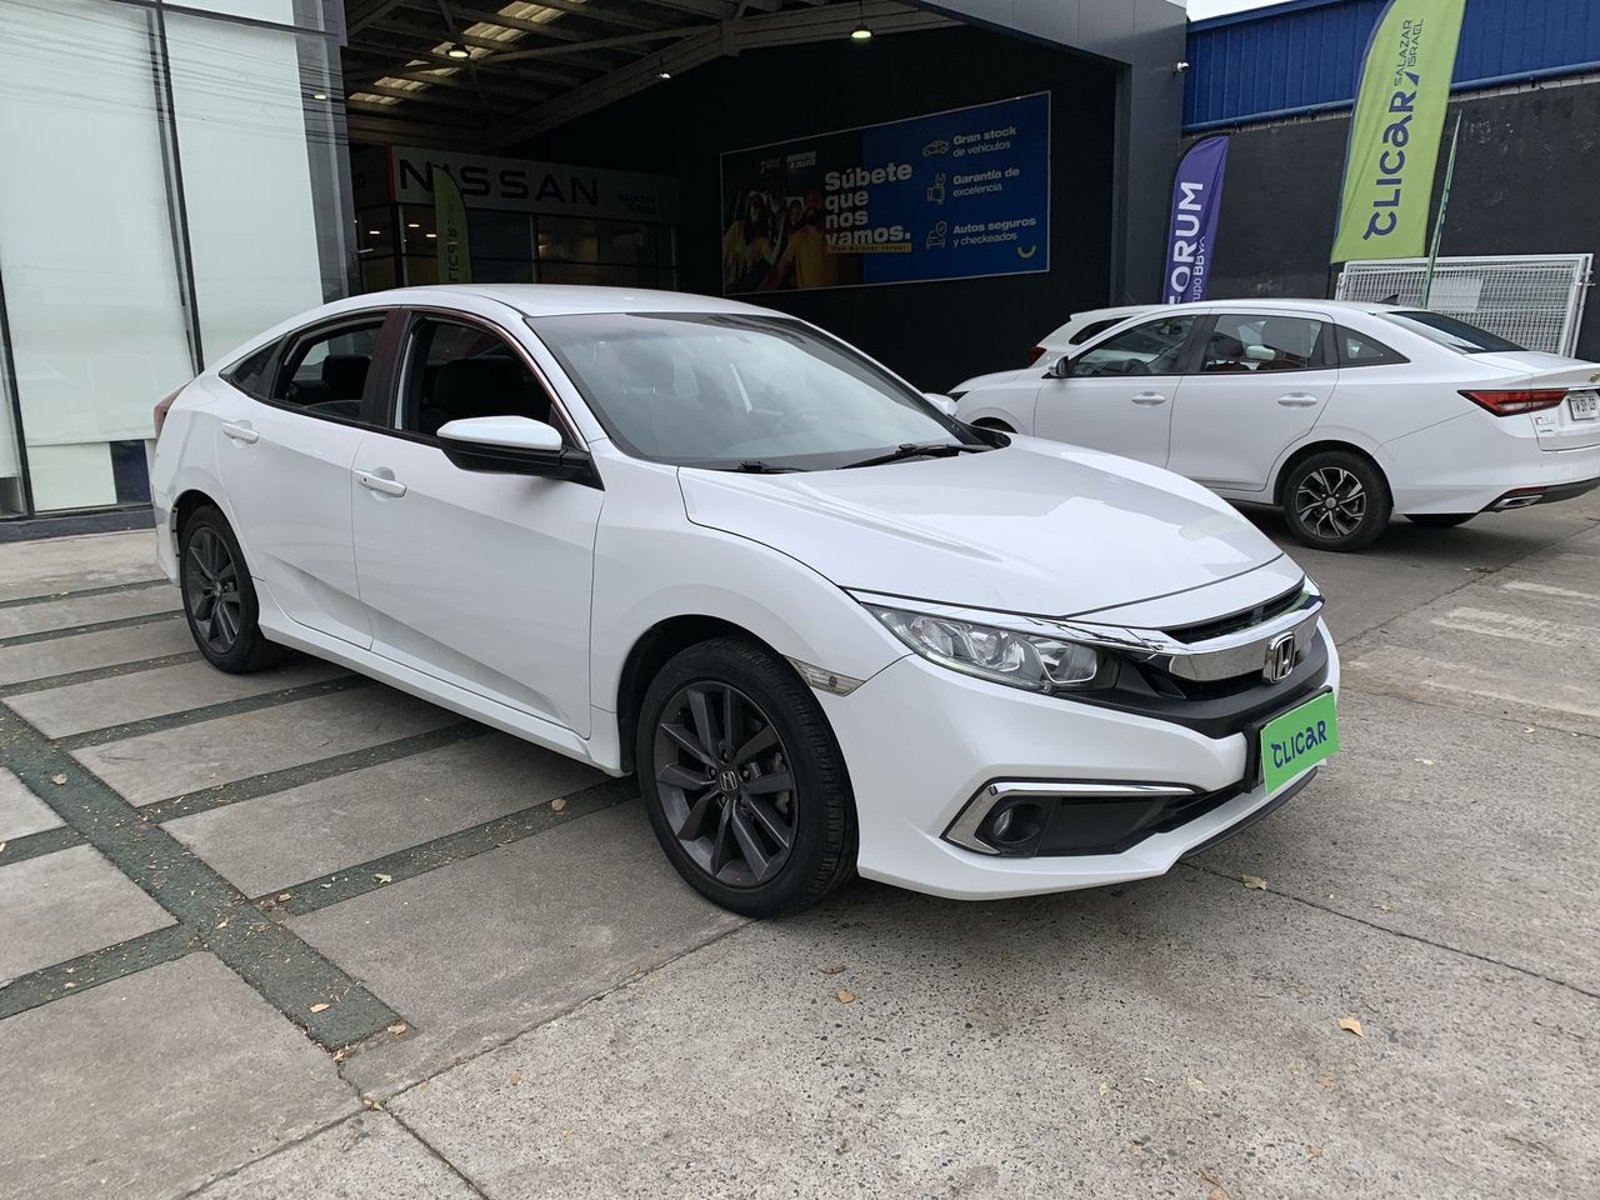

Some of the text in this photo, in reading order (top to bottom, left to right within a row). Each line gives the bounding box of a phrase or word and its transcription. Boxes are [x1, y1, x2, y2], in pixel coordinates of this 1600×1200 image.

[1395, 19, 1413, 86] SALAZAR
[1407, 19, 1424, 67] ISRAEL
[953, 126, 1017, 145] Gran stock
[953, 147, 965, 157] de
[400, 159, 599, 205] NSSAN
[824, 162, 913, 191] Súbete
[1004, 167, 1020, 178] de
[953, 182, 1002, 197] excelencia
[824, 190, 870, 214] que
[825, 209, 869, 229] nos
[953, 217, 1037, 234] Autos seguros
[825, 225, 911, 245] vamos.
[953, 238, 960, 248] y
[1193, 235, 1206, 276] BBVA
